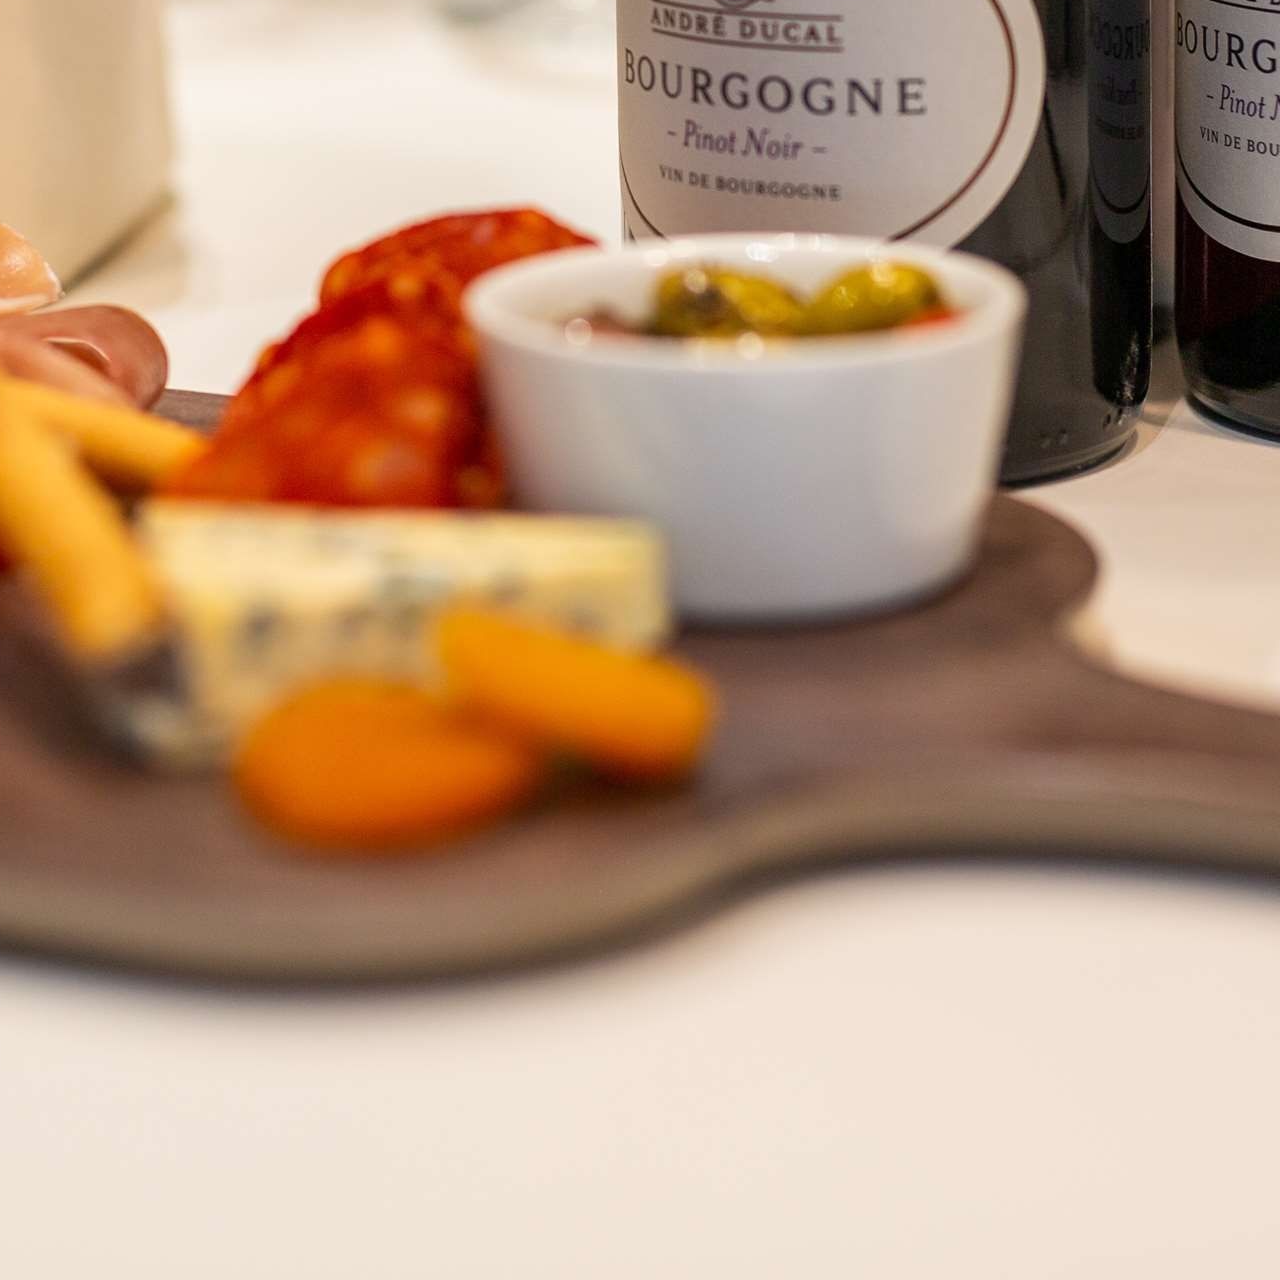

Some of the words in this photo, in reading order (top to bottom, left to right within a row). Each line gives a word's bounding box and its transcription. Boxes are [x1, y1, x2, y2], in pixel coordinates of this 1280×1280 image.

[739, 19, 843, 45] DUCAL
[624, 47, 928, 117] BOURGOGNE
[1219, 83, 1267, 120] Pinot
[683, 118, 737, 156] Pinot
[740, 125, 804, 160] Noir
[1199, 126, 1219, 144] VIN
[1223, 133, 1242, 151] DE
[658, 165, 684, 184] VIN
[687, 171, 711, 190] DE
[715, 175, 842, 202] BOURGOGNE
